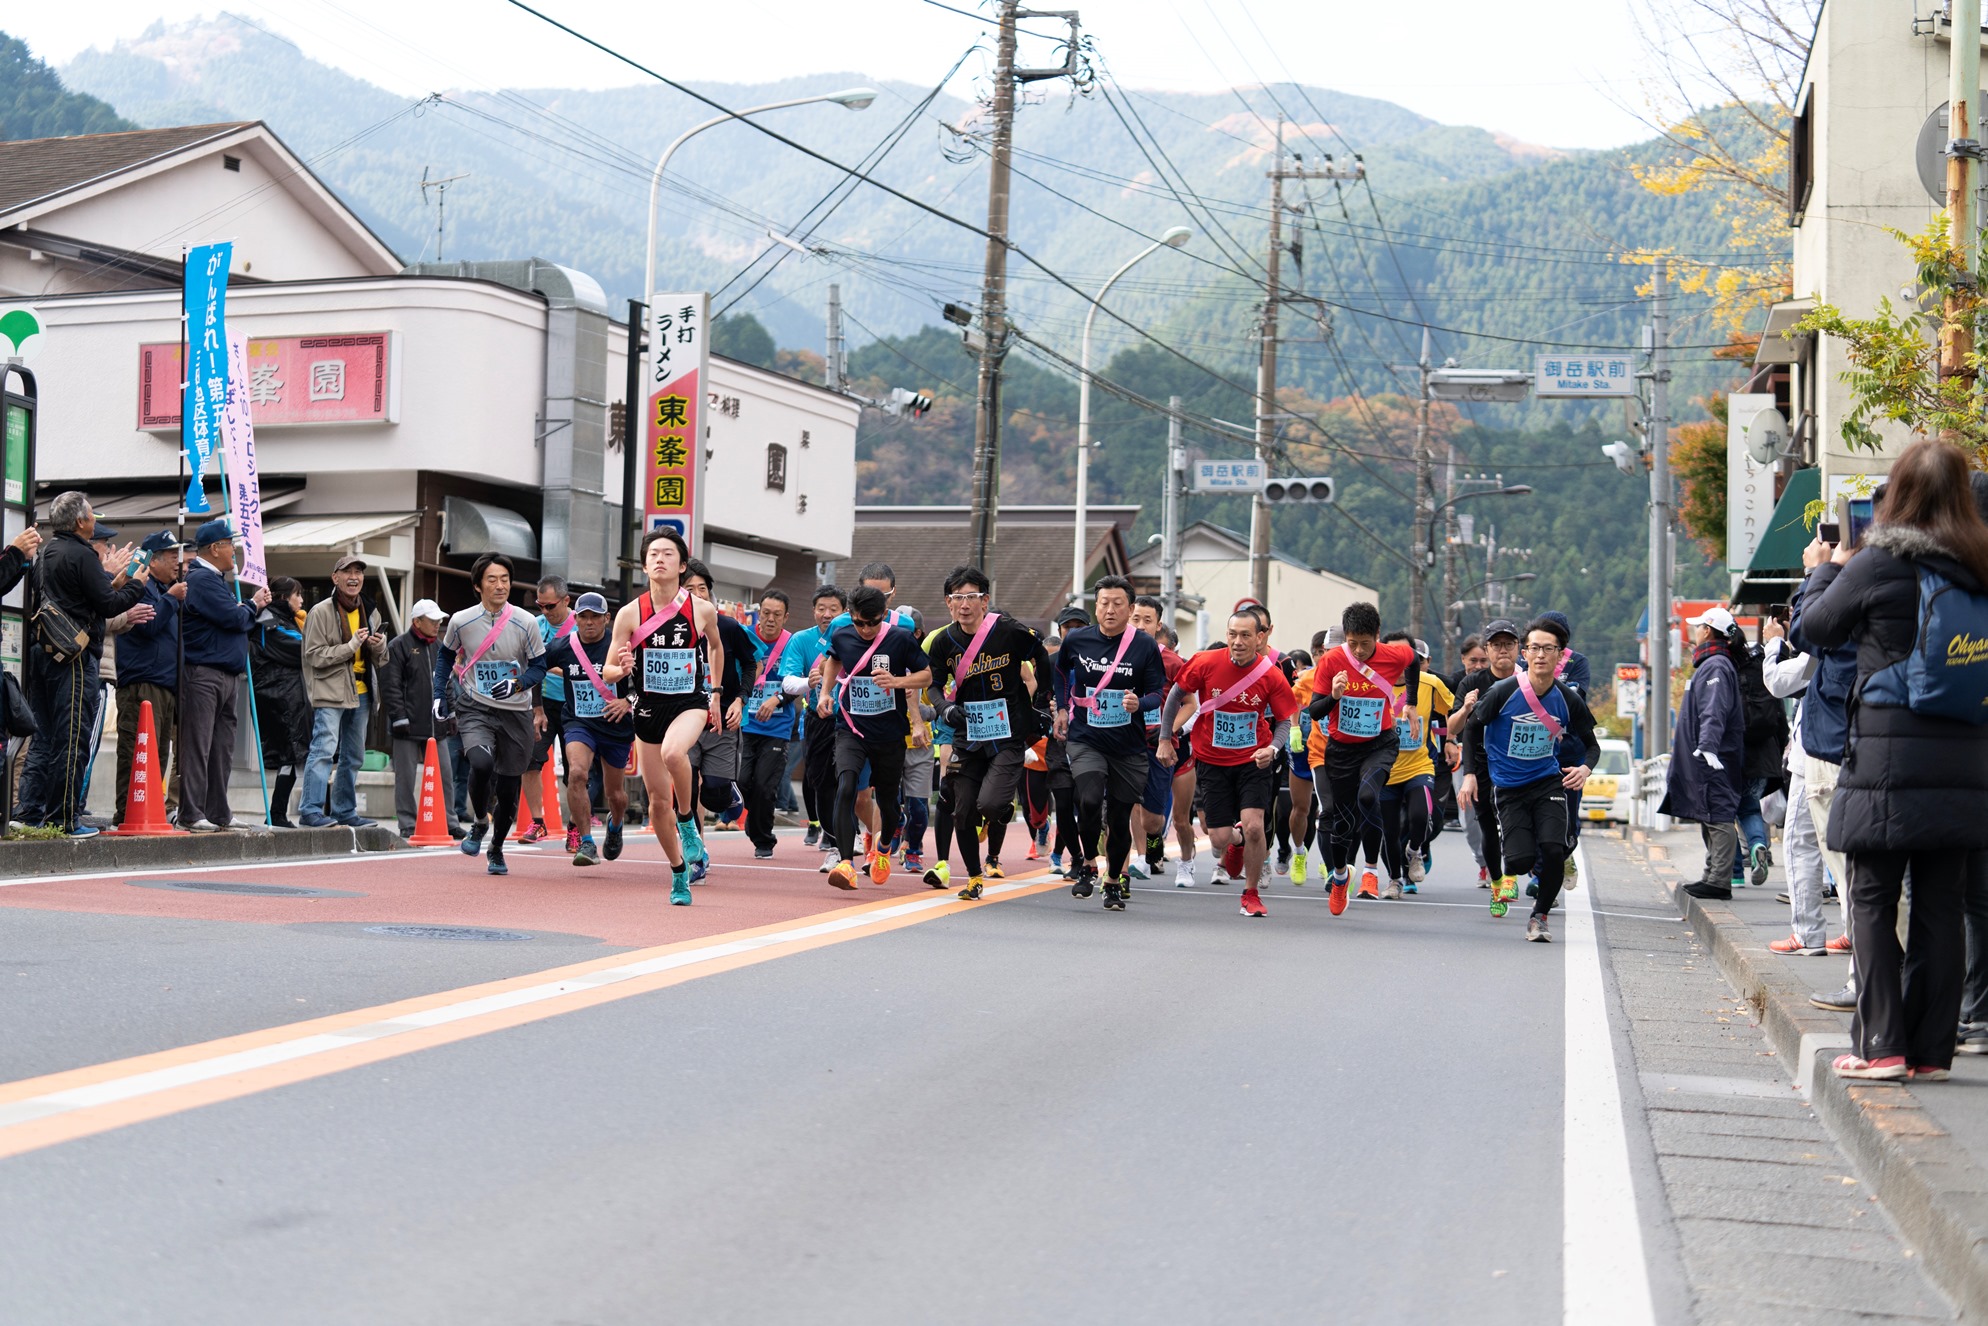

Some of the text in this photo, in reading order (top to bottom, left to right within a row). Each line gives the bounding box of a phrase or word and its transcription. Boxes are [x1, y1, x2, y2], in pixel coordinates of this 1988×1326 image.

[677, 305, 696, 343] 手打
[655, 314, 673, 382] ラーメン
[1544, 361, 1626, 377] 御岳駅前
[1557, 380, 1611, 388] Mitake Sta.
[656, 395, 688, 507] 東峯園
[1201, 465, 1259, 477] 御岳駅前
[651, 632, 685, 647] 相馬
[568, 663, 603, 676] 第支
[990, 673, 1003, 690] 3
[1211, 688, 1262, 706] 第支会
[1215, 732, 1255, 743] 第九支会
[133, 732, 148, 803] 青梅陸協
[423, 765, 435, 823] 青梅陸協
